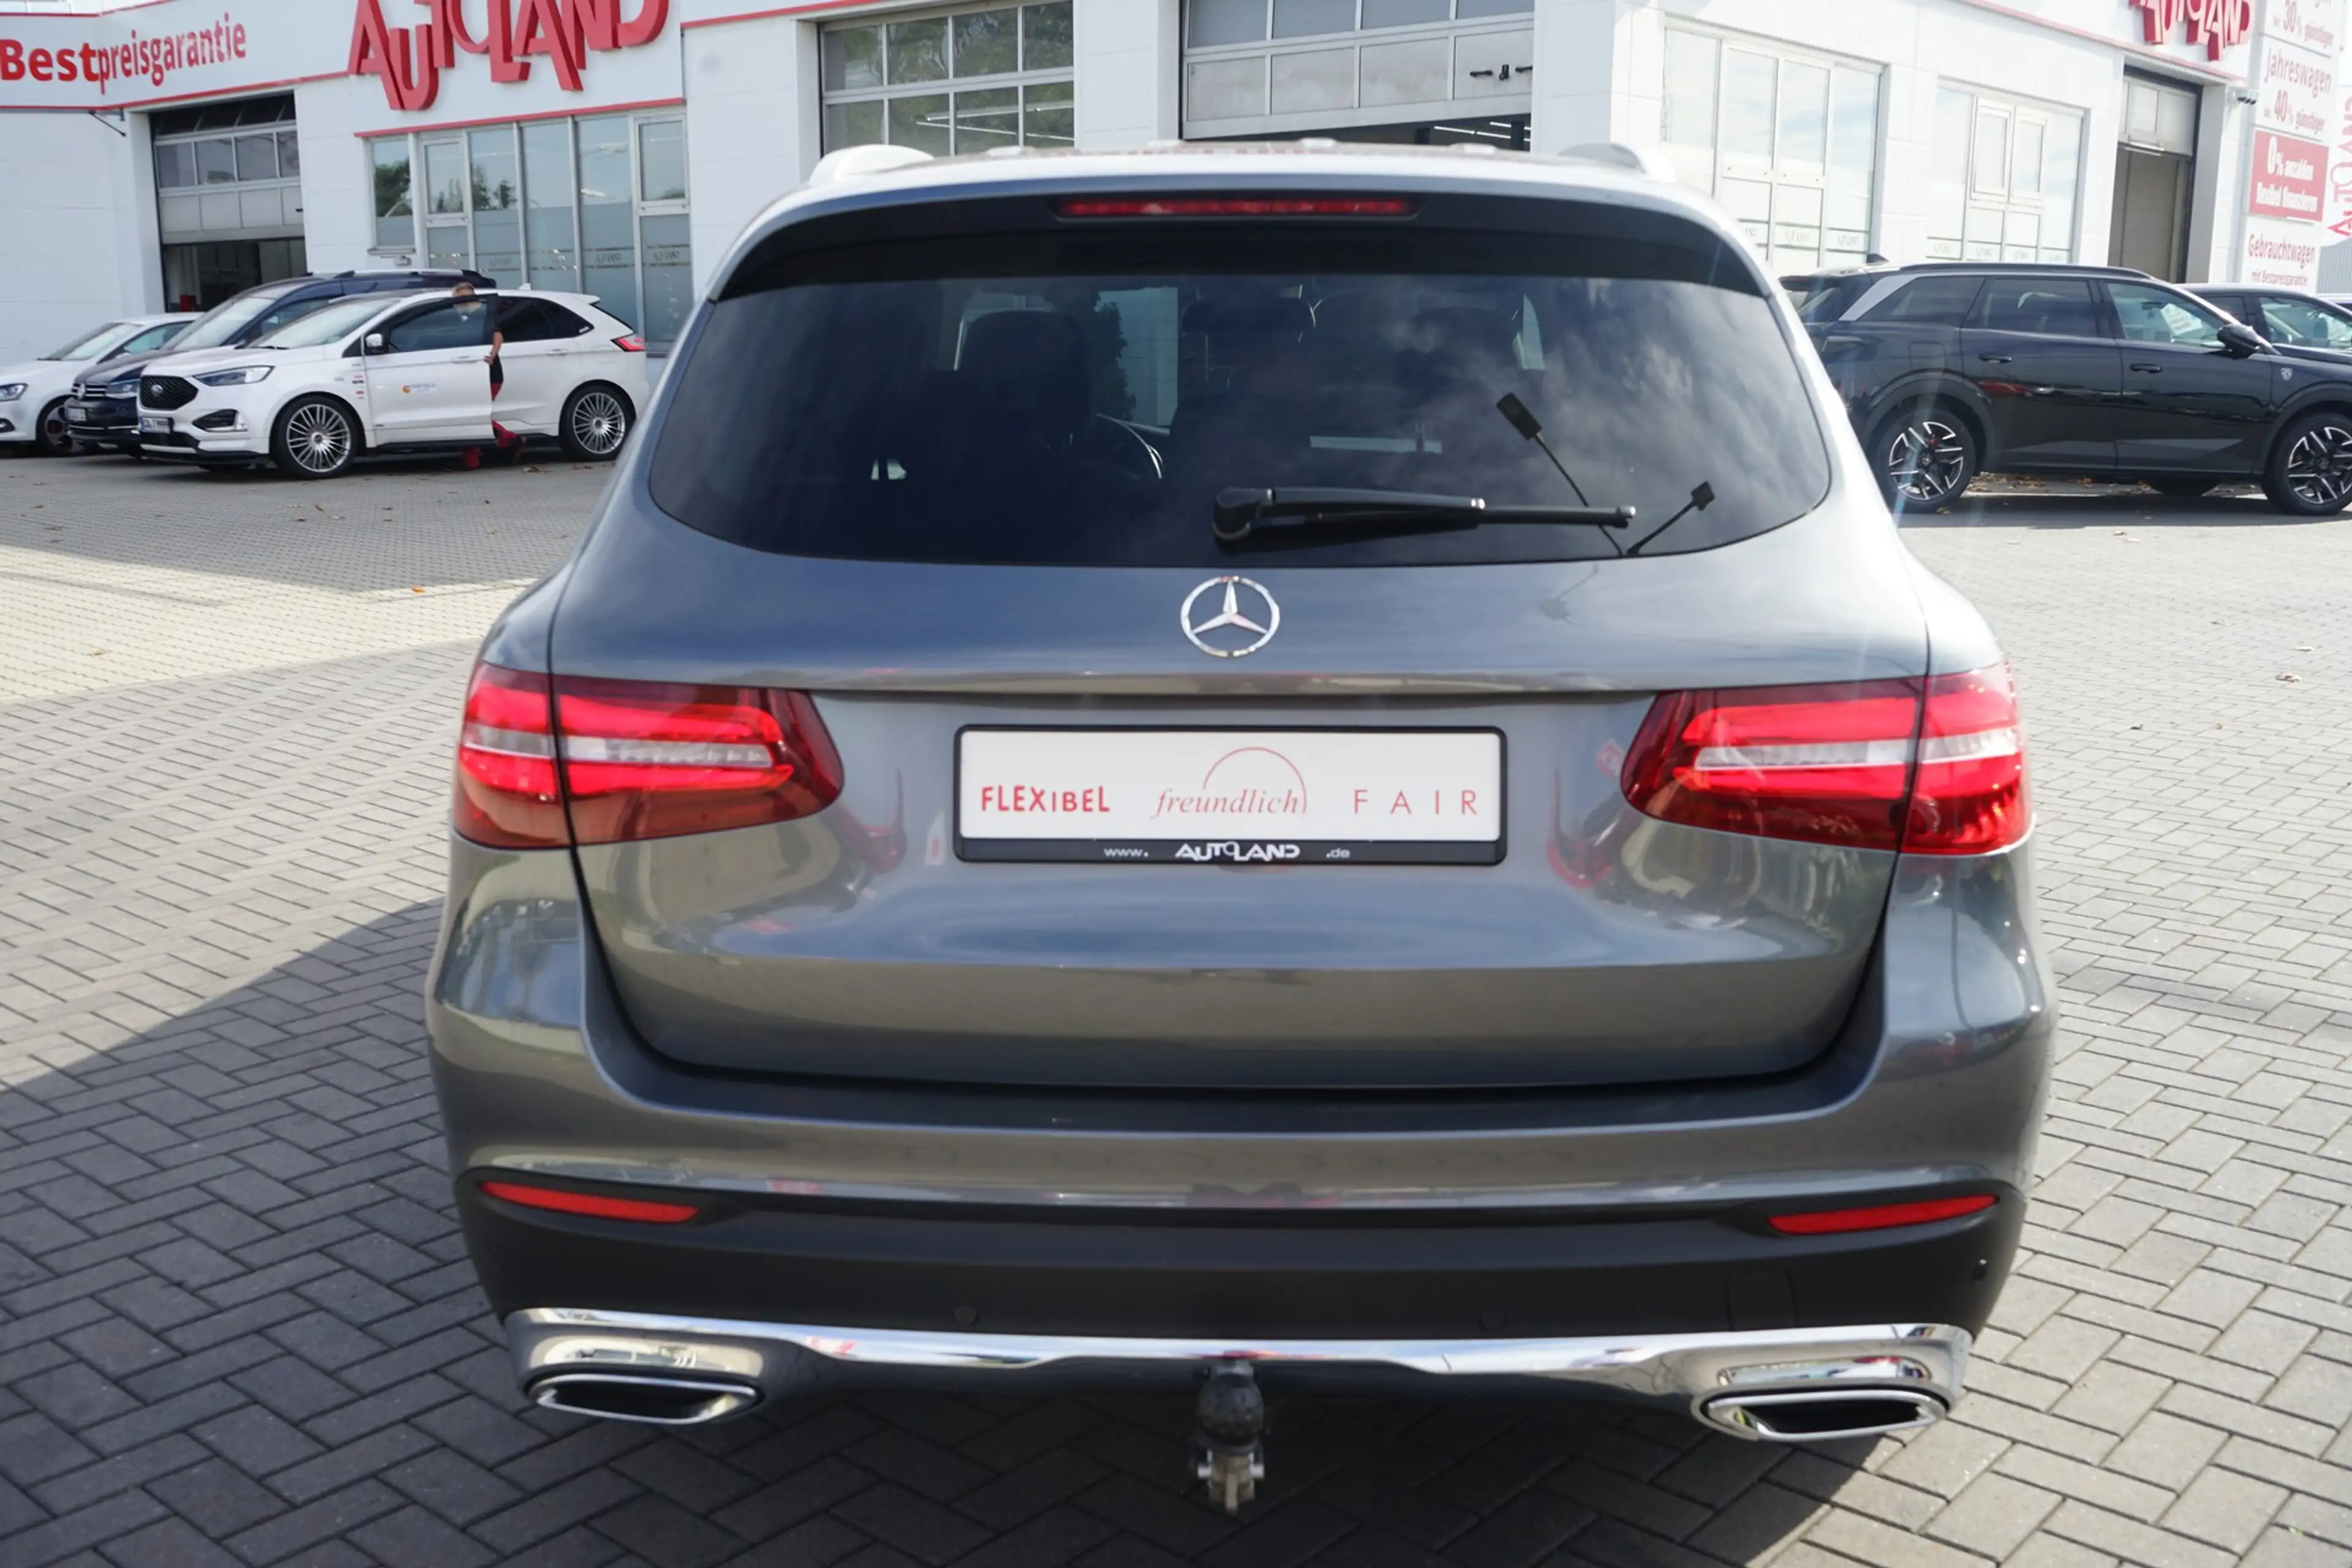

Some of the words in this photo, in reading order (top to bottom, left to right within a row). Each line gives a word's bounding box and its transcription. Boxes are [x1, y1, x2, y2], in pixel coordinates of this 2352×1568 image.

[0, 12, 246, 95] Bestpreisgarantie
[2264, 48, 2331, 99] Jahreswagen
[2248, 233, 2315, 269] Gebrauchtwagen
[981, 785, 1111, 812] FLEXIBEL
[1150, 788, 1298, 820] freundlich
[1354, 789, 1478, 815] FAIR
[1103, 846, 1149, 858] www.
[1175, 841, 1301, 862] AUTOLAND
[1325, 847, 1351, 859] .de
